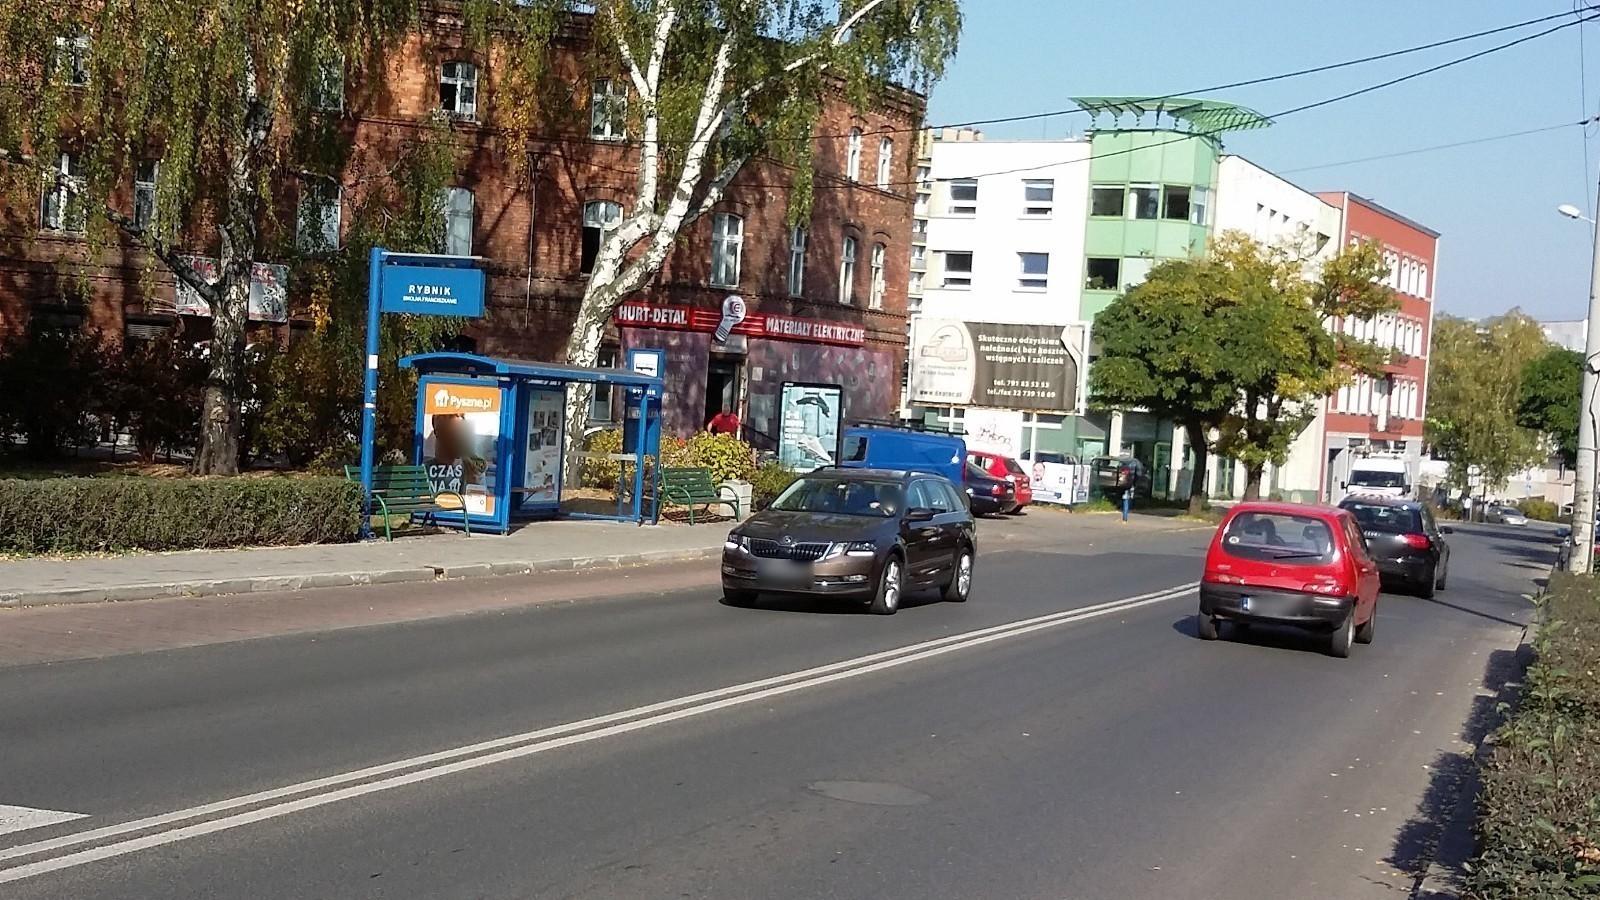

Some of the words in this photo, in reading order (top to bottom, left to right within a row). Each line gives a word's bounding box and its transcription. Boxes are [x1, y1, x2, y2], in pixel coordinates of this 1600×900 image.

[408, 285, 451, 295] RYBNIK
[619, 305, 688, 325] HURT-DETAL
[766, 317, 811, 336] MATERIAŁY
[813, 323, 865, 342] ELEKTRYCZNE
[450, 394, 493, 410] Pyszne.pl
[429, 464, 463, 478] CZAS
